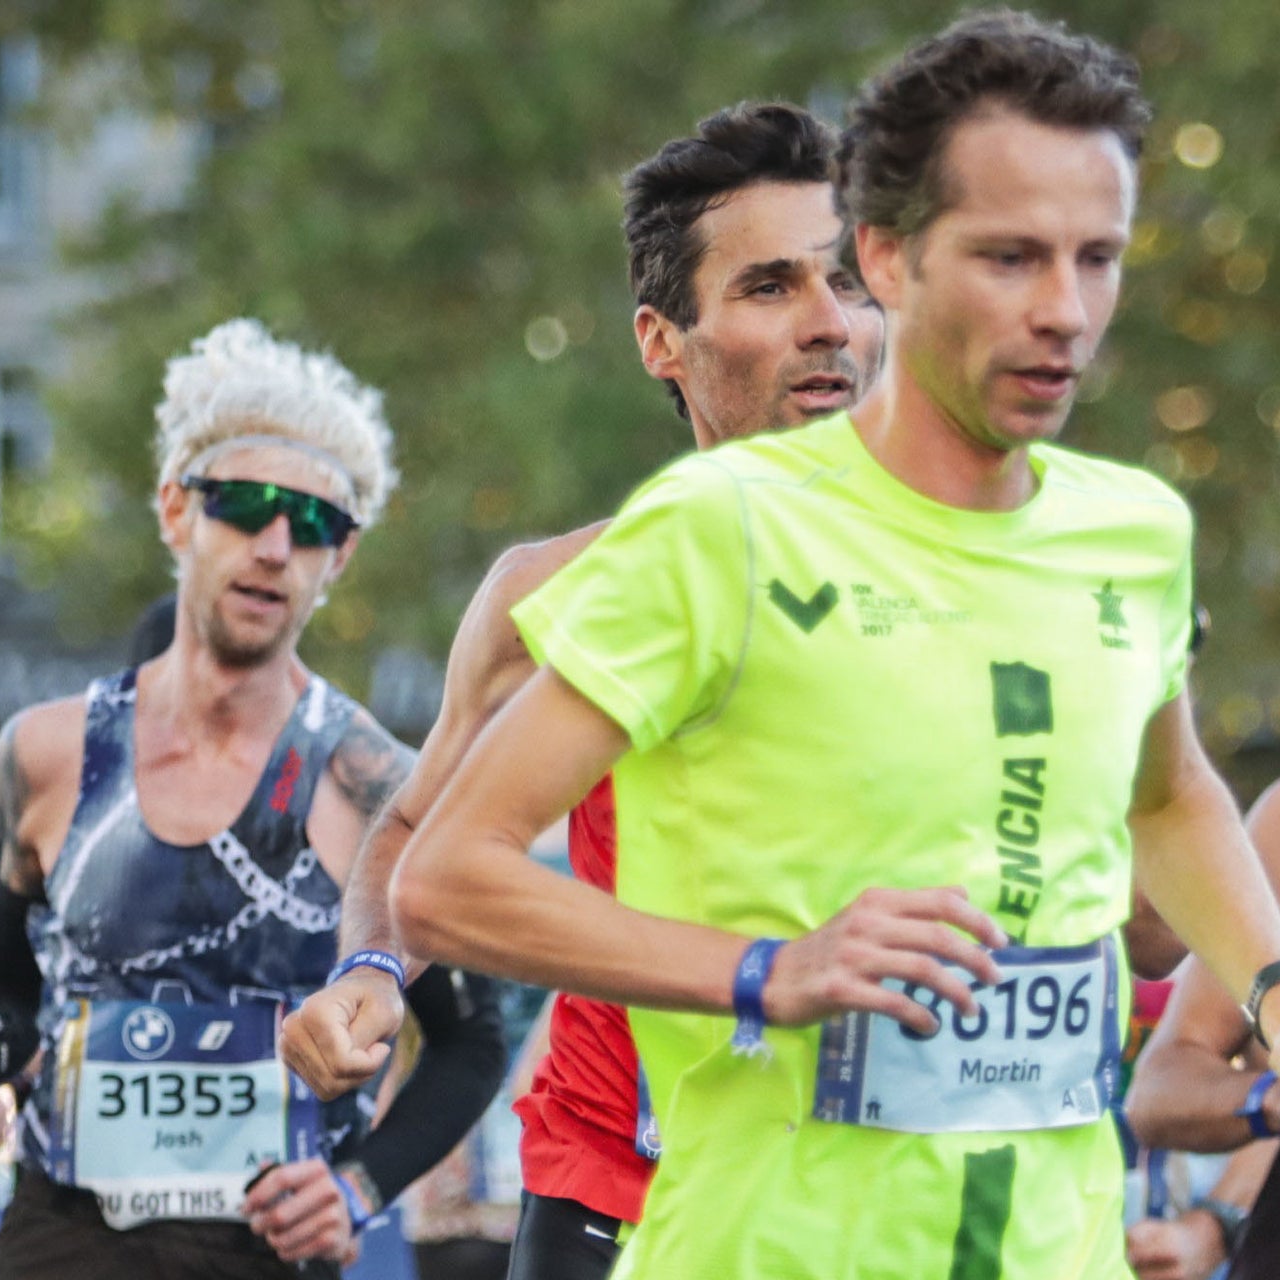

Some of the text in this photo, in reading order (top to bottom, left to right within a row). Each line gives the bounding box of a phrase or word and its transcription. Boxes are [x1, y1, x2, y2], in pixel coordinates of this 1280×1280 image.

[995, 757, 1047, 930] ENCIA
[959, 1058, 1041, 1085] Martin
[98, 1073, 257, 1118] 31353
[153, 1128, 203, 1149] Josh
[130, 1190, 172, 1216] GOT
[179, 1187, 226, 1212] THIS
